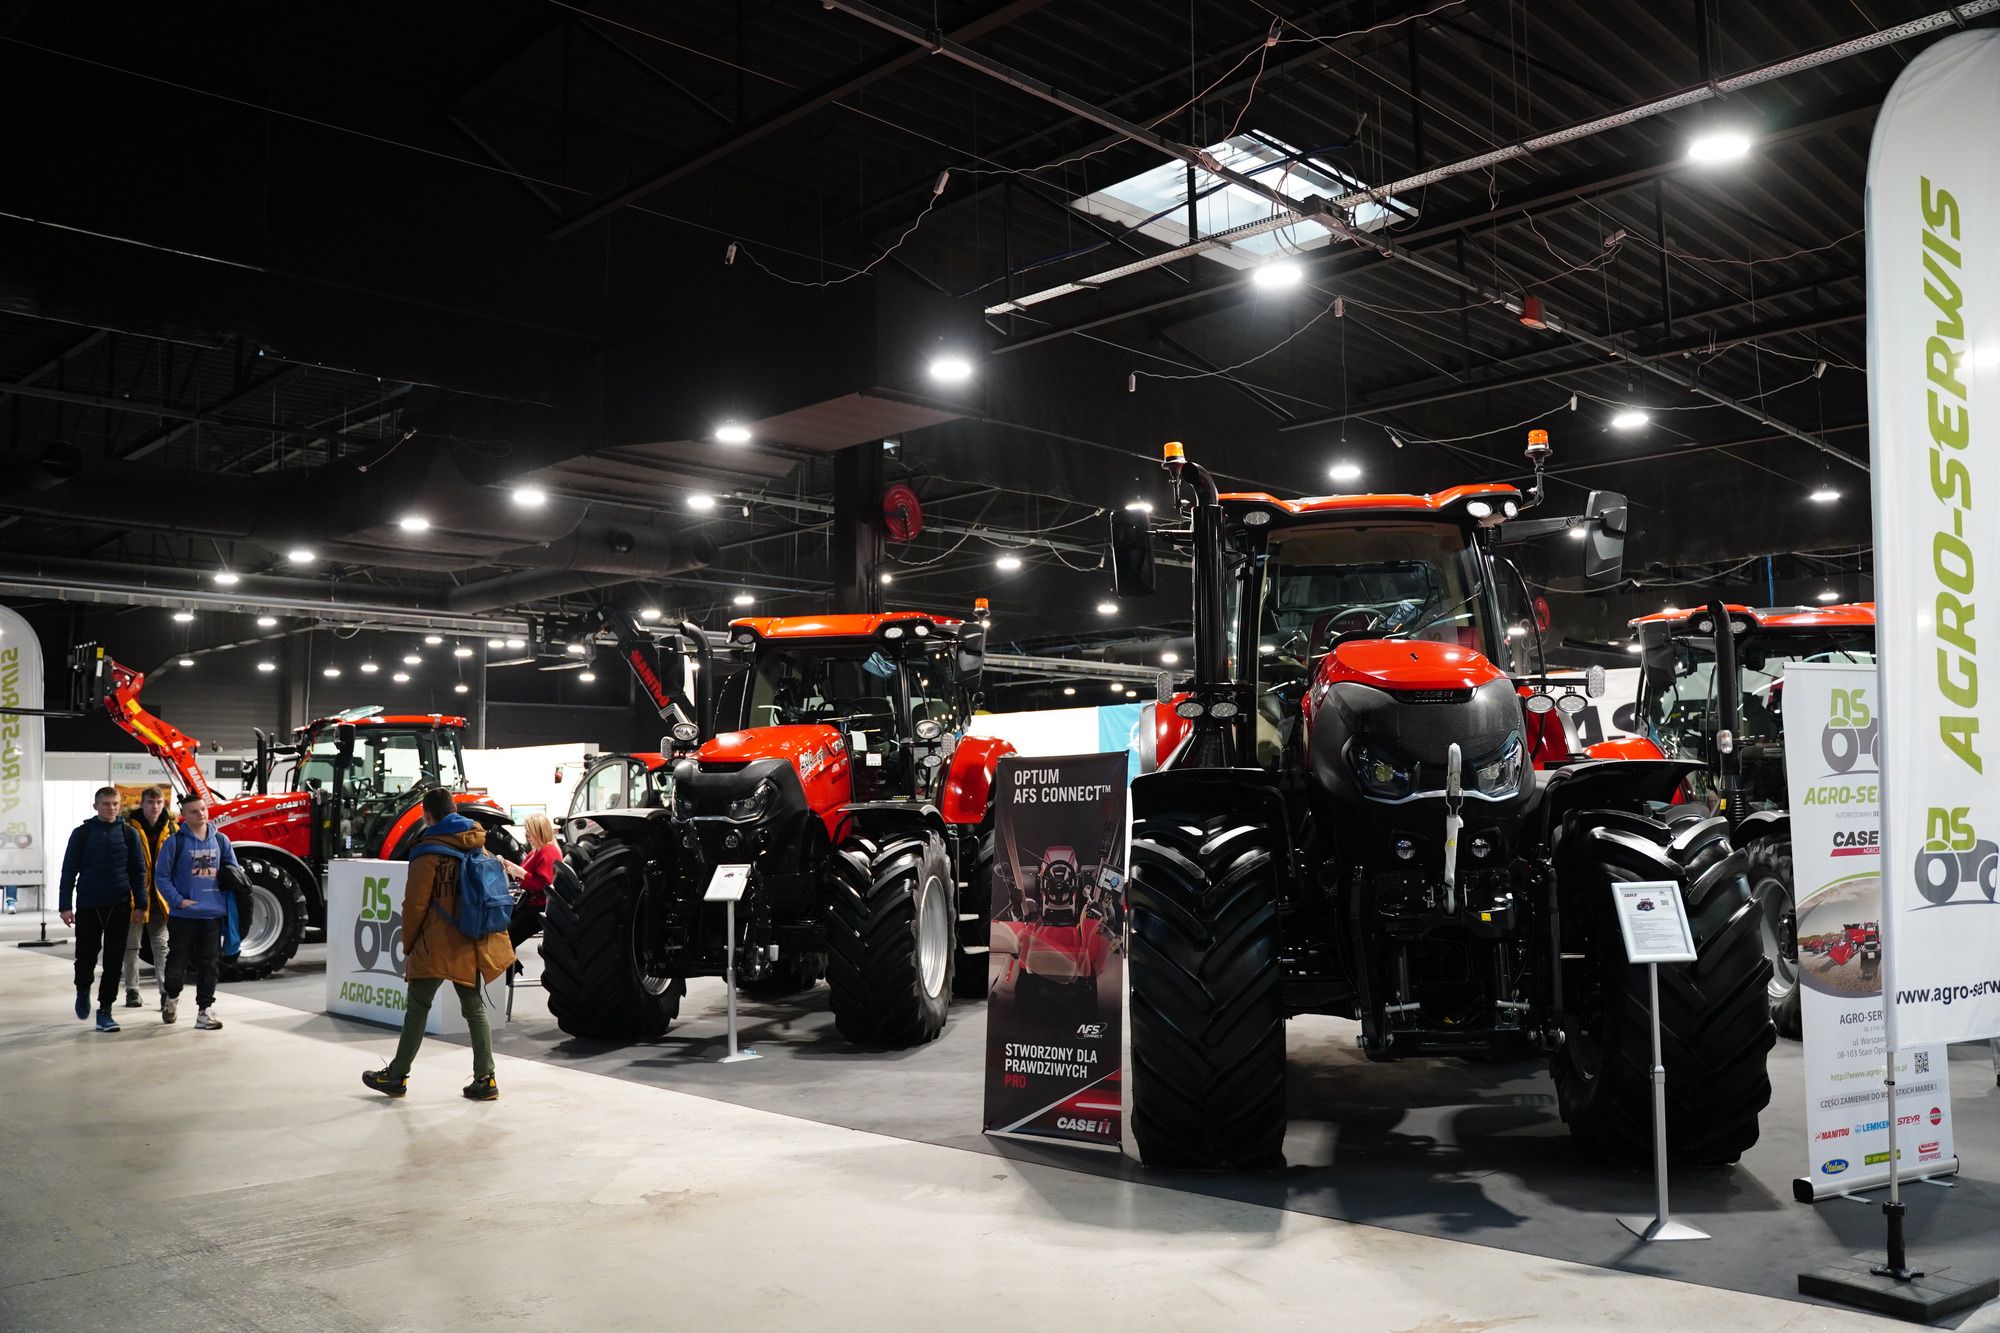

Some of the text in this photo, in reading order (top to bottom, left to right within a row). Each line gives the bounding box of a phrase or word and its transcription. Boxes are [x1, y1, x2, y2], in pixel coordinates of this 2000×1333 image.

[1920, 175, 1984, 777] AGRO-SERWIS
[1014, 768, 1060, 786] OPTUM
[1013, 789, 1037, 804] AFS
[1803, 785, 1880, 805] AGRO-SE
[1832, 830, 1880, 847] CASE
[1839, 1010, 1884, 1025] AGRO-SER
[1076, 1023, 1101, 1035] AFS
[1005, 1043, 1098, 1063] STWORZONY DLA
[1873, 1045, 1886, 1055] Opo
[1004, 1058, 1087, 1079] PRAWDZIWYCH
[1830, 1063, 1908, 1082] http://www.agro-is.pl
[1004, 1074, 1026, 1088] PRO
[1820, 1098, 1840, 1109] CZĘŚCI
[1840, 1093, 1870, 1105] ZAMIENNE
[1871, 1092, 1880, 1101] DO
[1881, 1088, 1915, 1099] WSSTKICH
[1914, 1084, 1935, 1094] MAREK
[1056, 1117, 1096, 1132] CASE
[1897, 1114, 1920, 1126] STEYR
[1821, 1128, 1849, 1140] MANITOU
